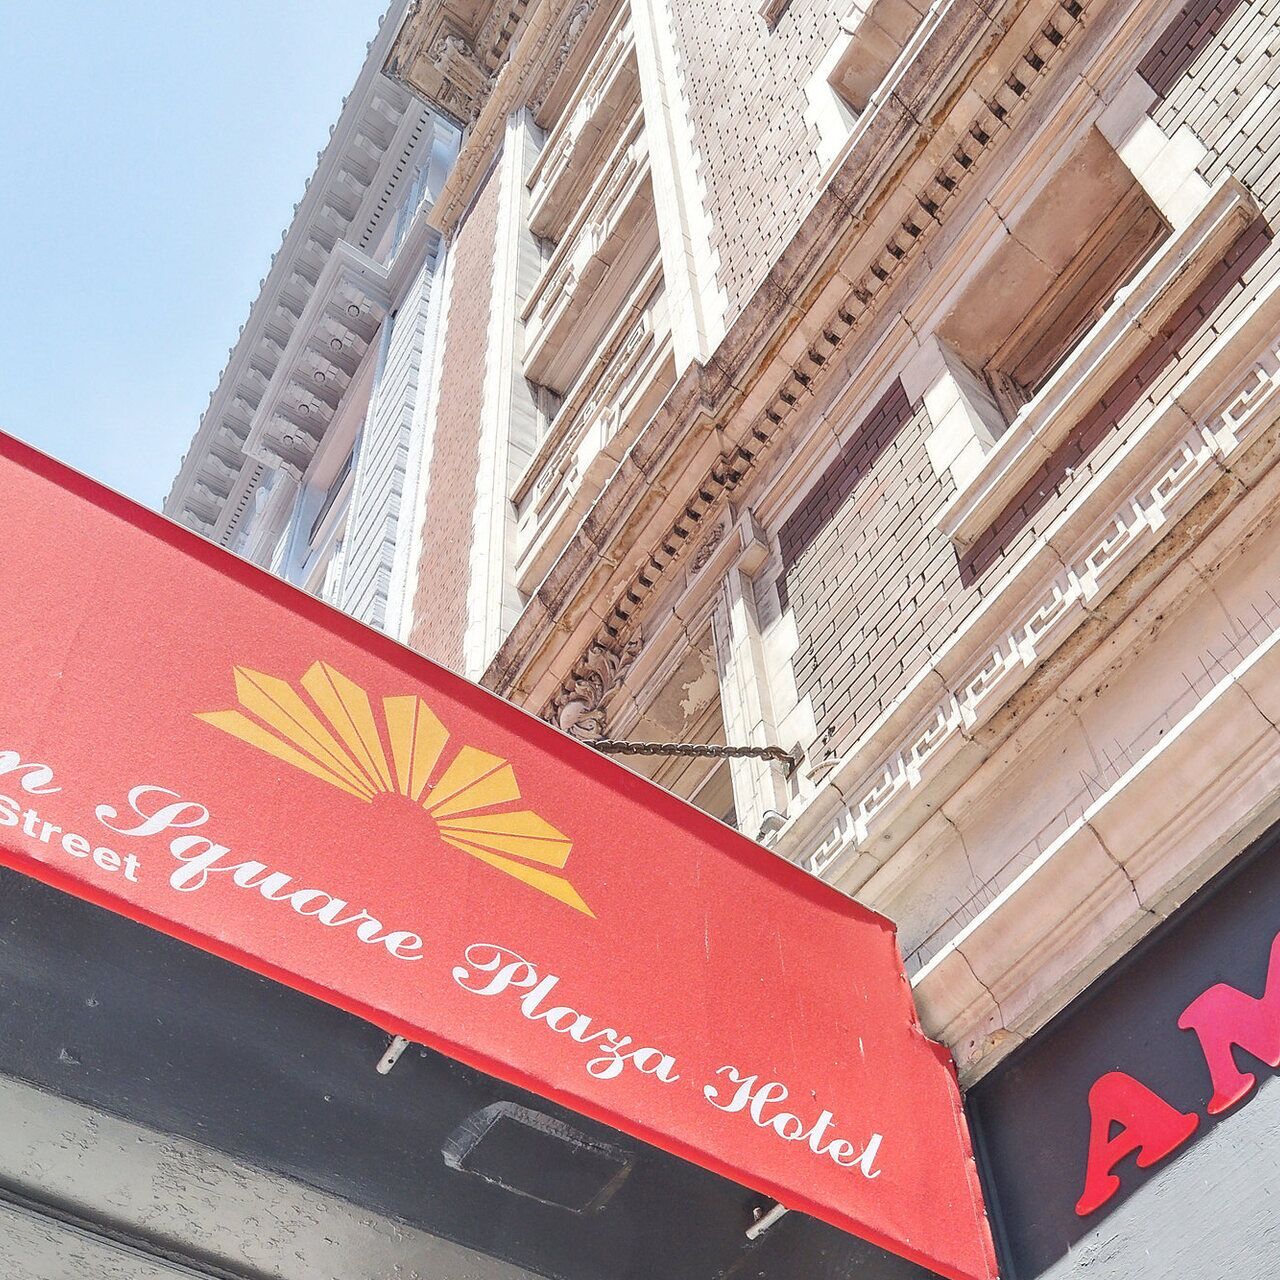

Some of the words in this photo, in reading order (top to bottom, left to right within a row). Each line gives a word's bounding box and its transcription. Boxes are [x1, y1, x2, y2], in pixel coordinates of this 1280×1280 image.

[95, 784, 424, 962] Square
[451, 942, 679, 1083] Plaza
[703, 1064, 883, 1180] Hotel
